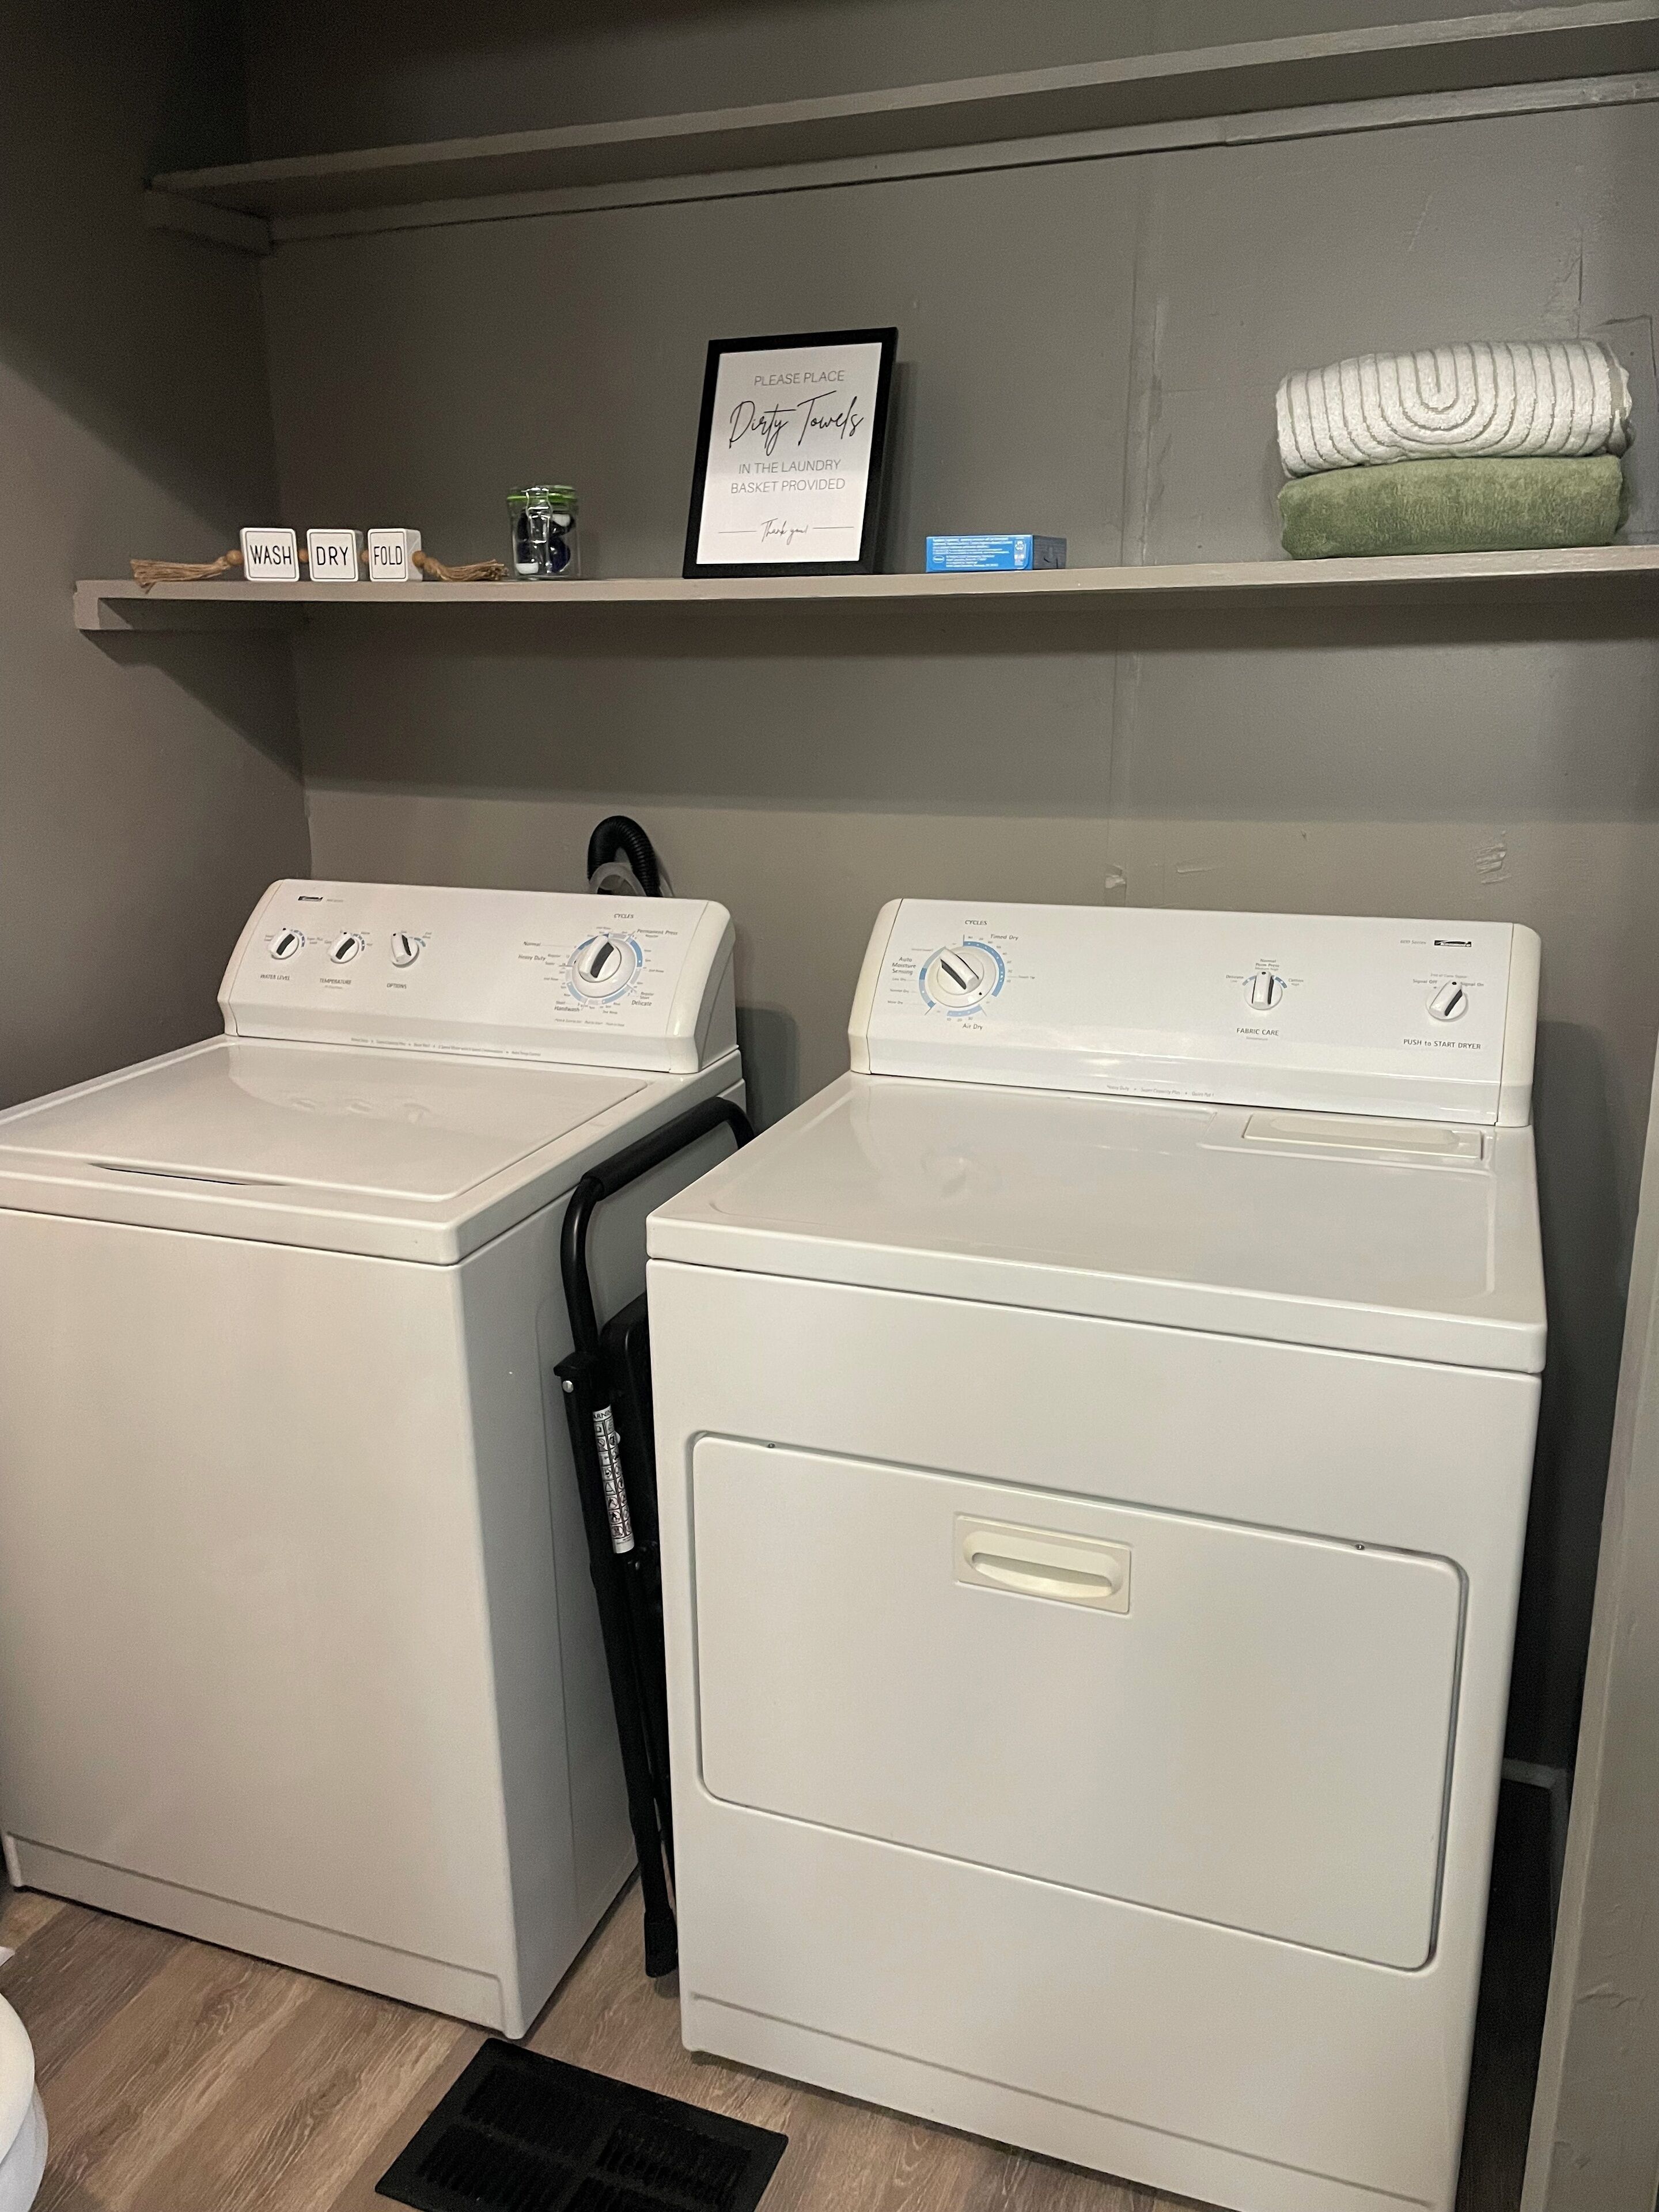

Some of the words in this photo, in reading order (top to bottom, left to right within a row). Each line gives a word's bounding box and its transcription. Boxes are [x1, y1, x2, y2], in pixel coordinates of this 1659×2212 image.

[754, 373, 800, 386] PLEASE
[804, 370, 845, 383] PLACE
[729, 400, 797, 456] Dirty
[797, 391, 864, 446] Towels
[738, 464, 750, 474] IN
[755, 461, 779, 473] THE
[781, 459, 842, 472] LAUNDRY
[730, 481, 777, 494] BASKET
[781, 478, 846, 492] PROVIDED
[761, 517, 786, 542] Thank
[249, 545, 292, 565] WASH
[316, 546, 349, 566] DRY
[374, 546, 403, 565] FOLD
